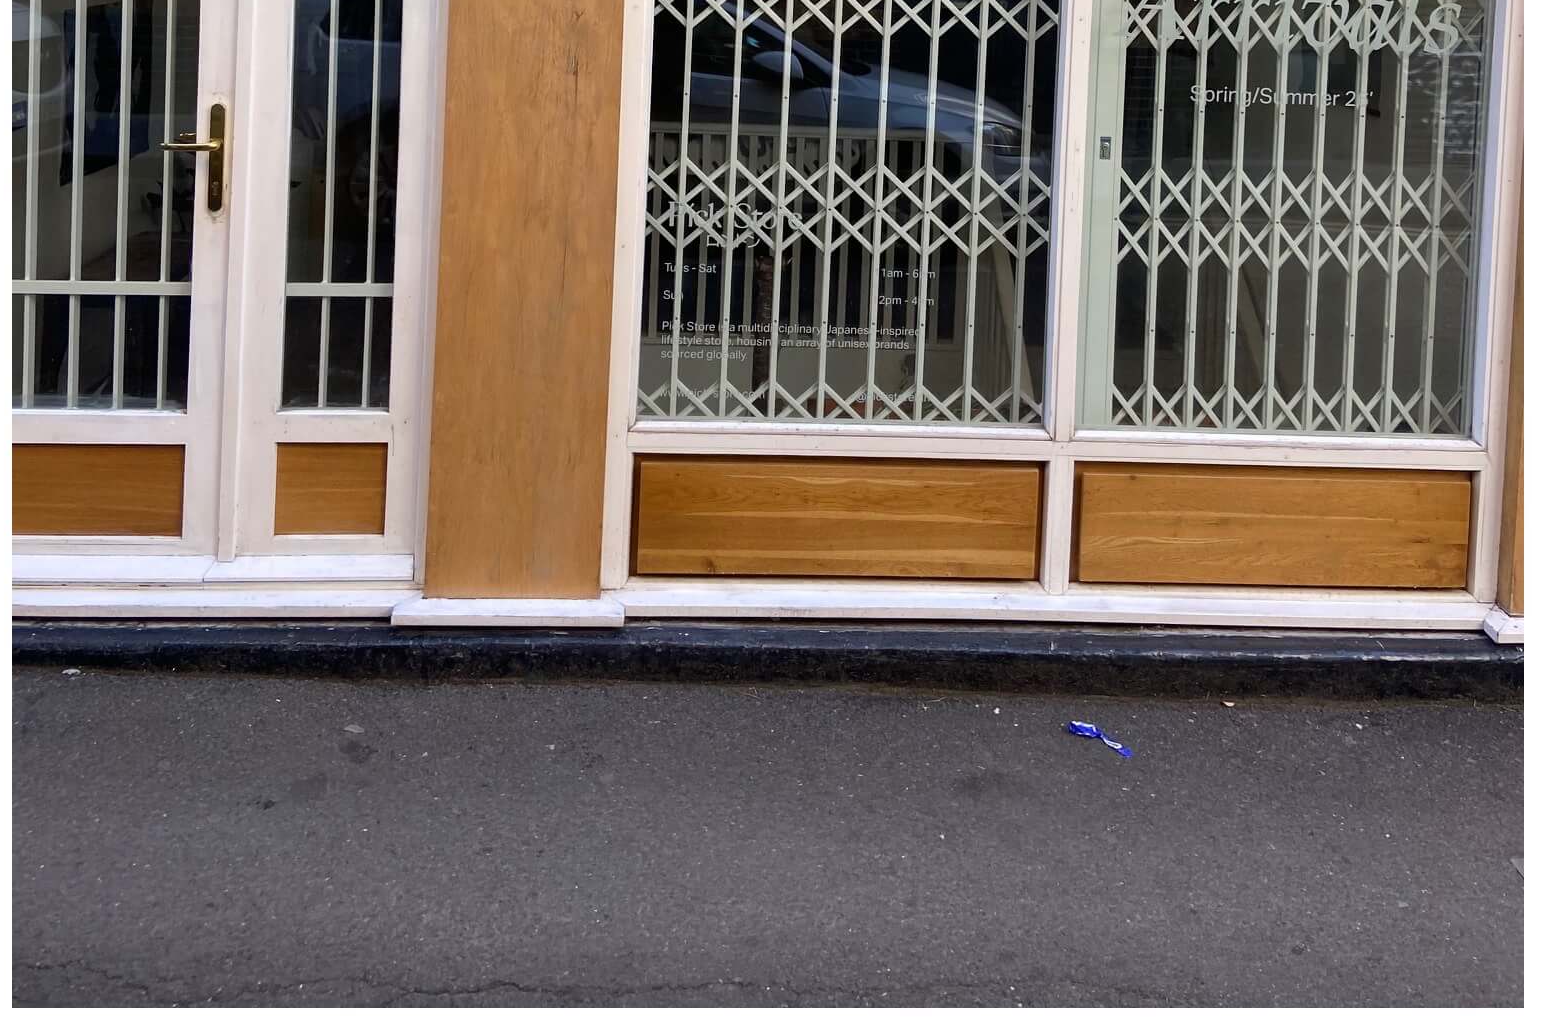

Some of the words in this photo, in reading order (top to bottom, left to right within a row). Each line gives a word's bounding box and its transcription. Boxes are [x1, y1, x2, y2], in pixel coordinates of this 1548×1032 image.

[1345, 90, 1373, 107] 2'
[734, 202, 803, 230] Stoe
[664, 262, 690, 273] Tus
[698, 263, 717, 274] Sat
[912, 268, 936, 280] 6m
[663, 289, 684, 301] Su
[911, 296, 935, 307] 4m
[661, 320, 684, 331] Pik
[686, 321, 716, 332] Store
[737, 322, 821, 336] multidiciplinary
[826, 324, 920, 337] Japanes-inspire
[661, 334, 703, 347] lifstyle
[704, 336, 734, 346] sto,
[736, 335, 775, 347] housin
[660, 350, 704, 359] sorced
[706, 349, 748, 361] gloally.
